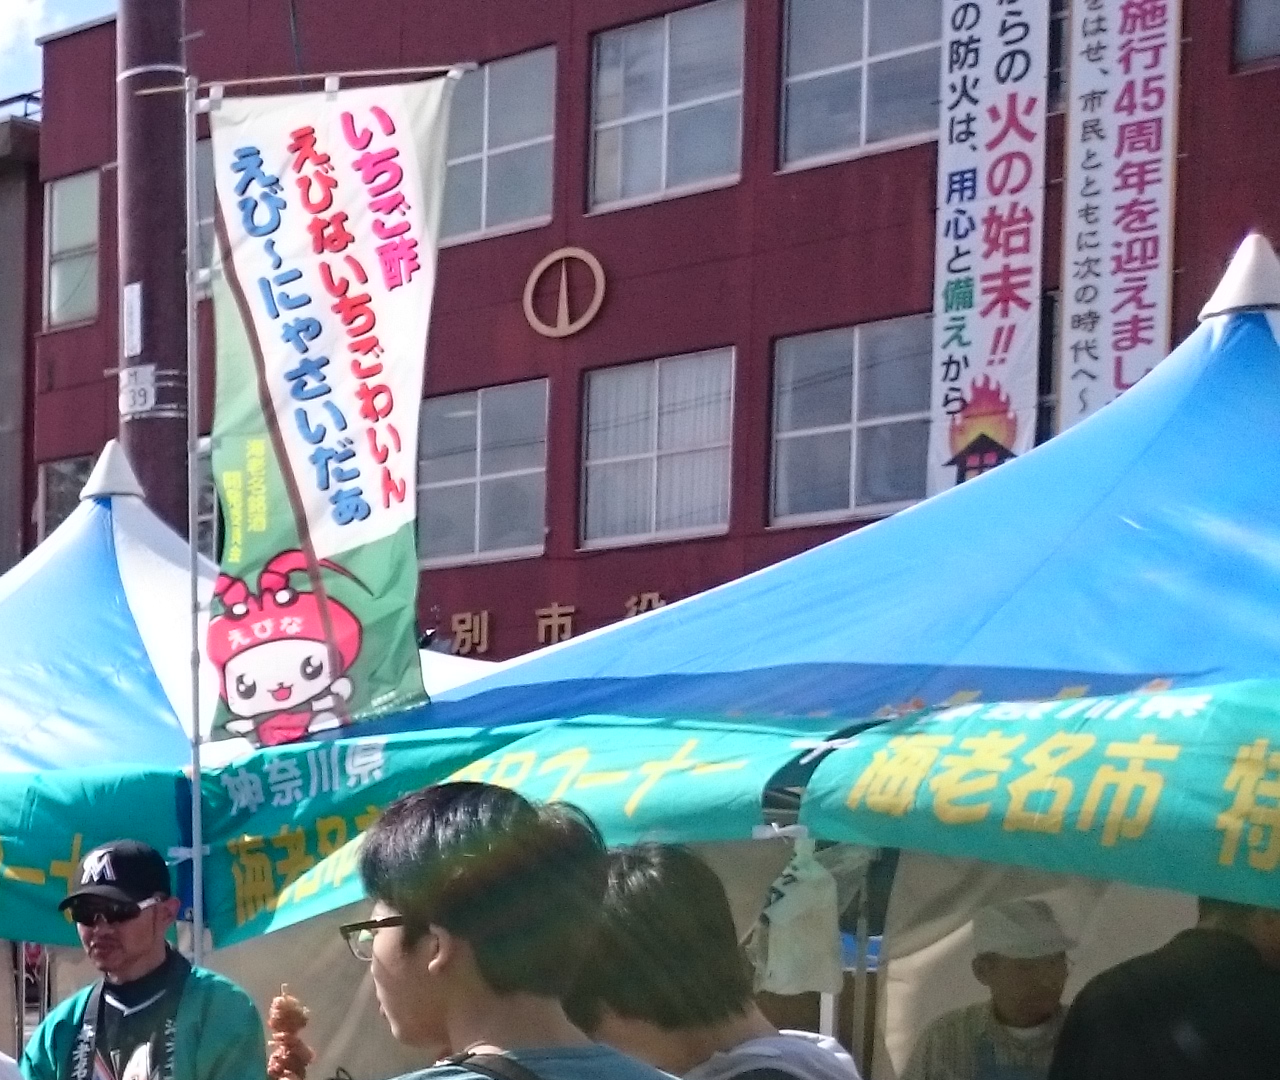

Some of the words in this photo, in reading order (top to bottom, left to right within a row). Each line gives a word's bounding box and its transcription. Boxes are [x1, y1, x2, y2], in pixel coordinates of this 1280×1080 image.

[287, 126, 407, 509] えびないちごわいん
[340, 106, 421, 292] いちご酢
[979, 0, 1038, 367] らの火の始末!!
[1107, 0, 1168, 404] 施行45周年を迎えまし
[220, 736, 389, 817] 神奈川県
[847, 730, 1181, 847] 海老名市
